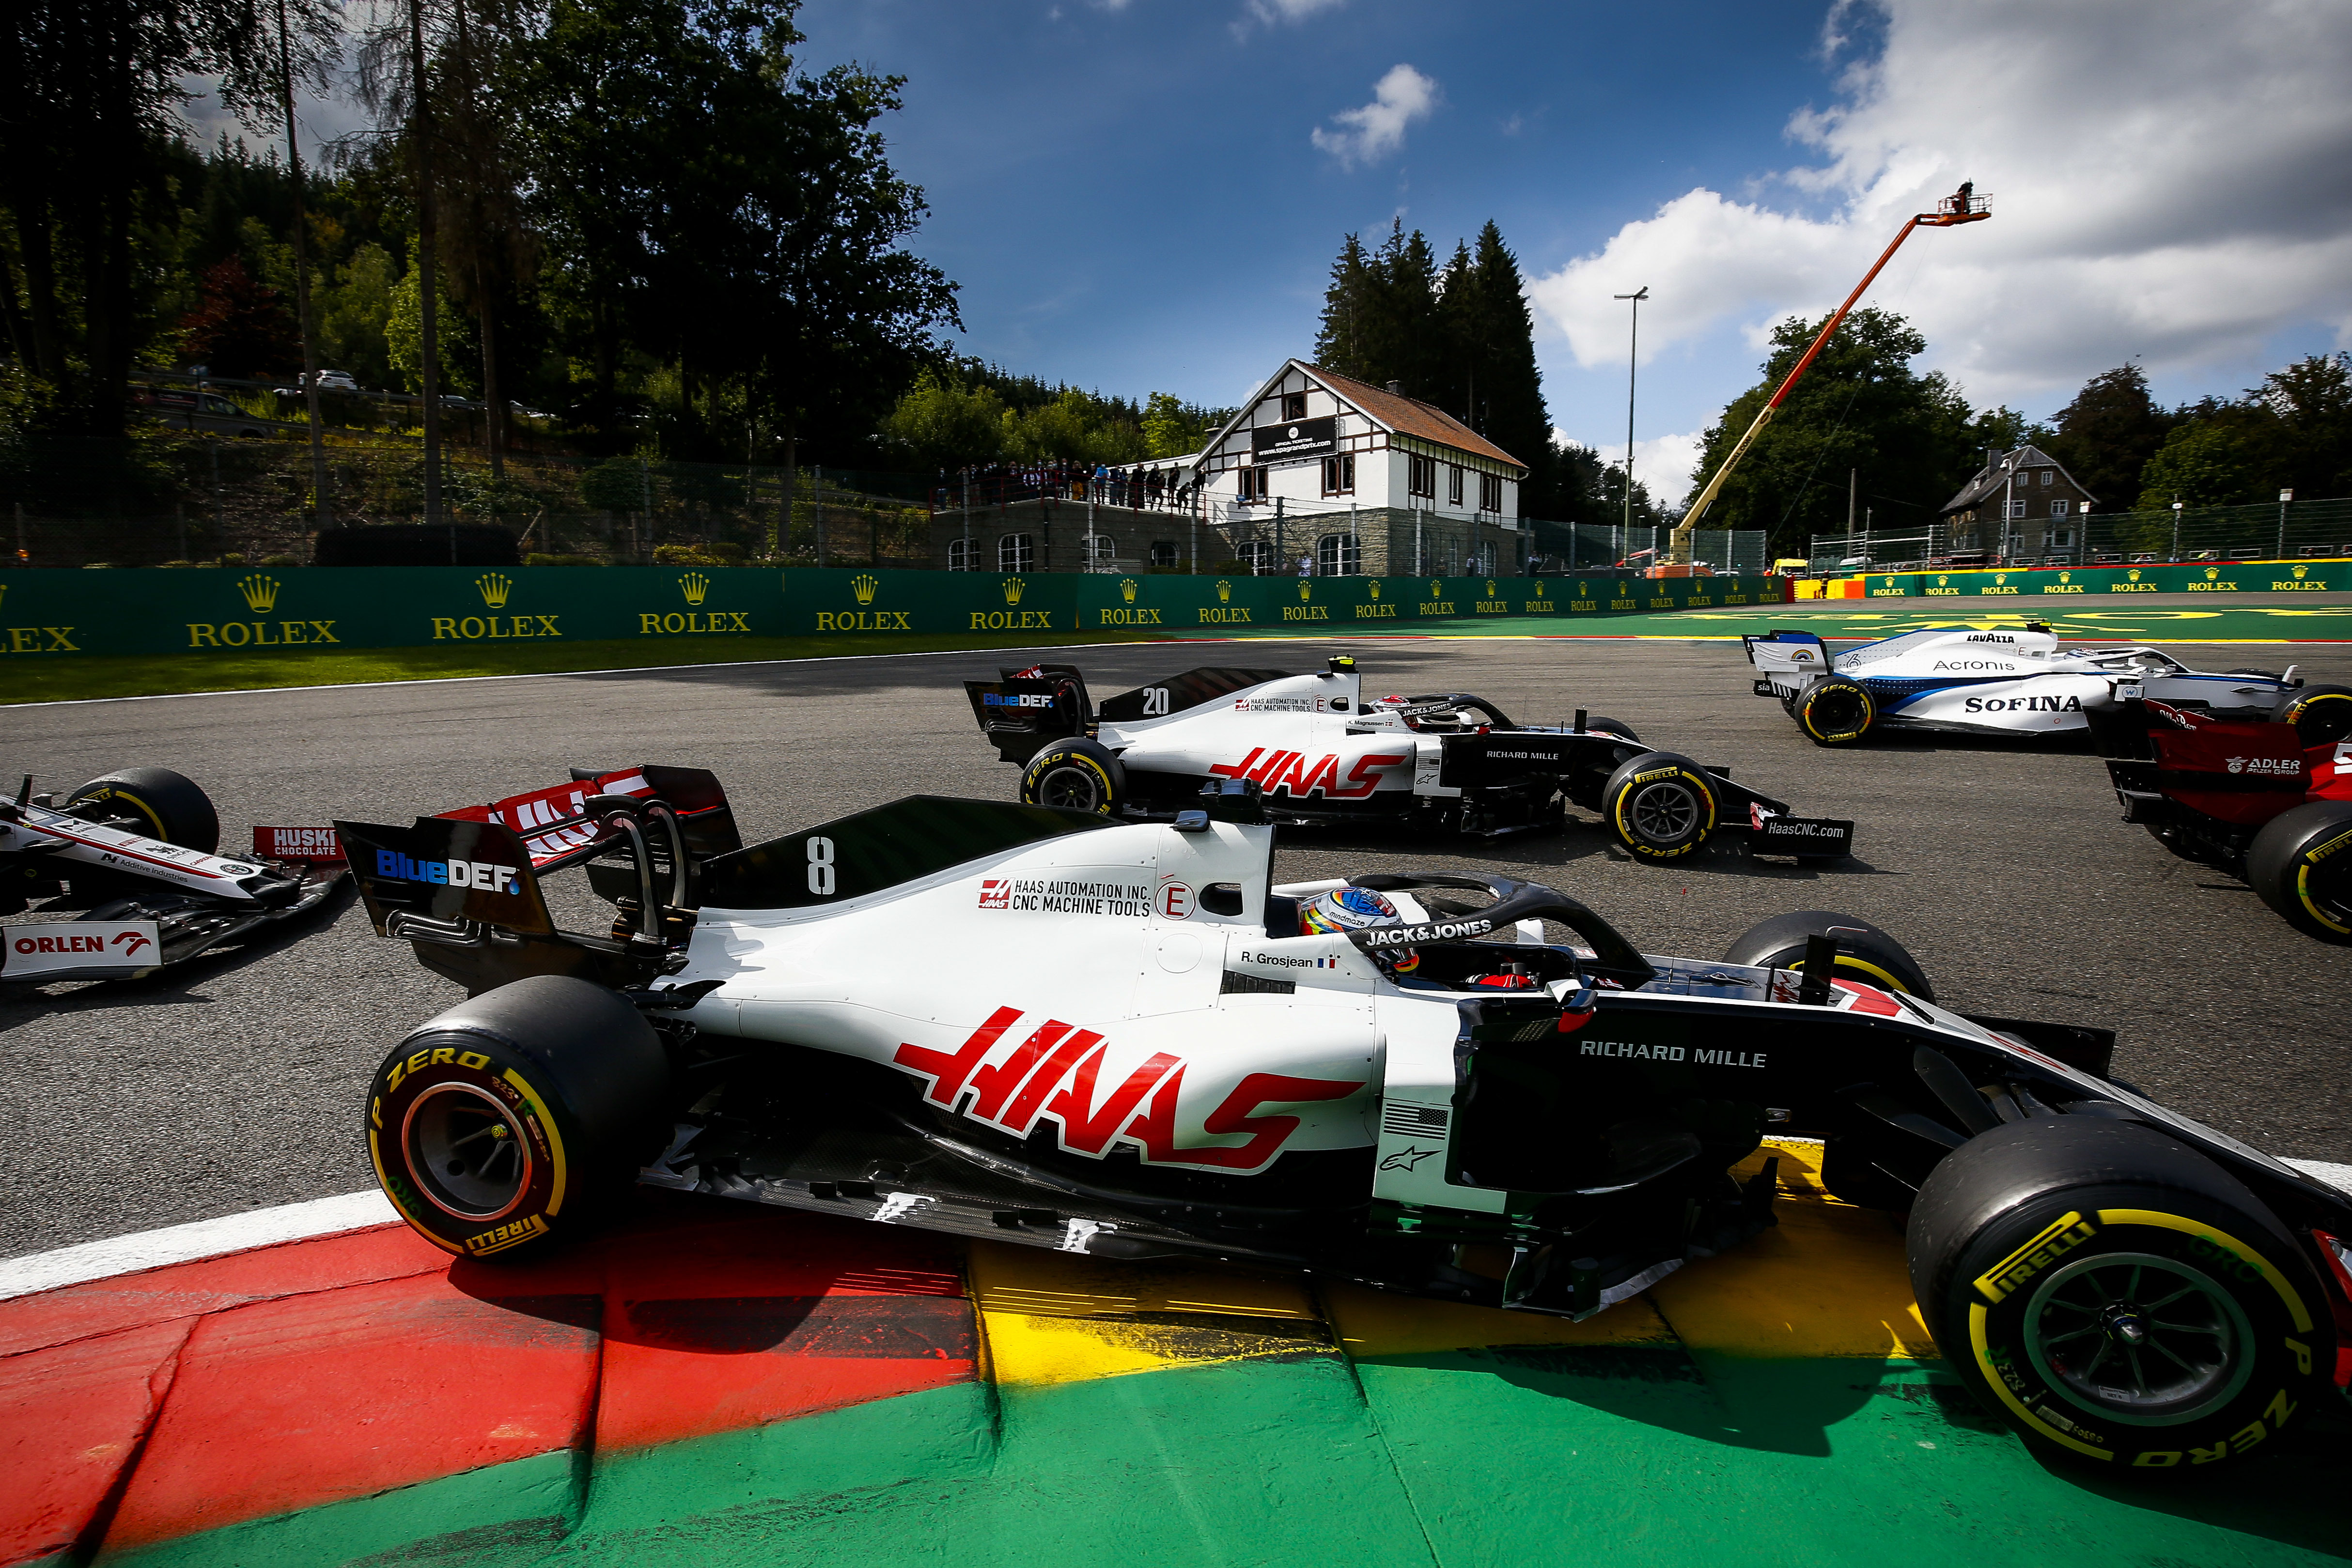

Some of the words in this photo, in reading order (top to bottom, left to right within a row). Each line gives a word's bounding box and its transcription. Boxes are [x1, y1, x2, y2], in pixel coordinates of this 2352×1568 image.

[1258, 440, 1331, 456] www.spagrandprix.com
[2112, 584, 2157, 592] ROLEX
[2188, 582, 2238, 591] ROLEX
[2272, 582, 2327, 590] ROLEX
[1571, 601, 1596, 611] ROLEX
[1611, 600, 1635, 610] ROLEX
[1651, 598, 1673, 607] ROLEX
[1688, 596, 1711, 606] ROLEX
[1725, 594, 1746, 604] ROLEX
[1760, 593, 1780, 602] ROLEX
[1199, 608, 1251, 622] ROLEX
[1283, 606, 1328, 620] ROLEX
[1356, 604, 1396, 618] ROLEX
[1420, 602, 1454, 615] ROLEX
[1477, 601, 1507, 613] ROLEX
[1526, 601, 1553, 612] ROLEX
[639, 612, 750, 633] ROLEX
[817, 612, 911, 630] ROLEX
[970, 611, 1051, 629] ROLEX
[1101, 609, 1162, 624] ROLEX
[187, 621, 340, 647] ROLEX
[432, 615, 561, 638] ROLEX
[1966, 634, 2015, 644] LAVAZZA
[1846, 653, 1861, 670] 6
[1933, 660, 2015, 671] Acronis
[1820, 684, 1858, 695] ZERO
[983, 692, 1053, 708] BlueDEF
[1143, 687, 1169, 715] 20
[1316, 699, 1325, 712] E
[1965, 695, 2084, 713] SOFINA
[1402, 703, 1452, 716] JACK&JONES
[1827, 732, 1857, 742] PIRELLI
[1486, 750, 1528, 759] RICHARD
[1530, 751, 1559, 761] MILLE
[2248, 759, 2300, 769] ADLER
[1027, 752, 1064, 789] ZERO
[1208, 747, 1407, 799] HAAS
[1634, 766, 1678, 783] PIRELLI
[274, 829, 336, 846] HUSKI
[1698, 828, 1707, 841] P
[1769, 822, 1844, 839] HaasCNC.com
[275, 847, 336, 855] CHOCOLATE
[1636, 842, 1692, 857] ZERO
[121, 859, 151, 873] Additive
[151, 867, 188, 883] Industries
[377, 850, 519, 892] BlueDEF
[807, 836, 836, 895] 8
[1015, 880, 1044, 894] HAAS
[1047, 881, 1124, 899] AUTOMATION
[1127, 885, 1152, 900] INC.
[1012, 895, 1038, 911] CNC
[1043, 897, 1103, 915] MACHINE
[1107, 900, 1151, 917] TOOLS
[1166, 886, 1186, 916] E
[1329, 911, 1366, 927] mindmaze
[1366, 919, 1492, 947] JACK&JONES
[15, 935, 104, 955] ORLEN
[1241, 951, 1254, 963] R.
[1257, 953, 1313, 968] Grosjean
[1580, 1040, 1686, 1062] RICHARD
[1693, 1048, 1767, 1069] MILLE
[372, 1096, 383, 1130] P
[387, 1048, 491, 1093] ZERO
[893, 1005, 1367, 1169] HAAS
[387, 1176, 422, 1220] GRO
[465, 1213, 550, 1256] PIRELLI
[1973, 1211, 2099, 1305] PIRELLI
[2186, 1234, 2263, 1284] GRO
[2284, 1336, 2312, 1376] P
[2132, 1388, 2298, 1467] ZERO
